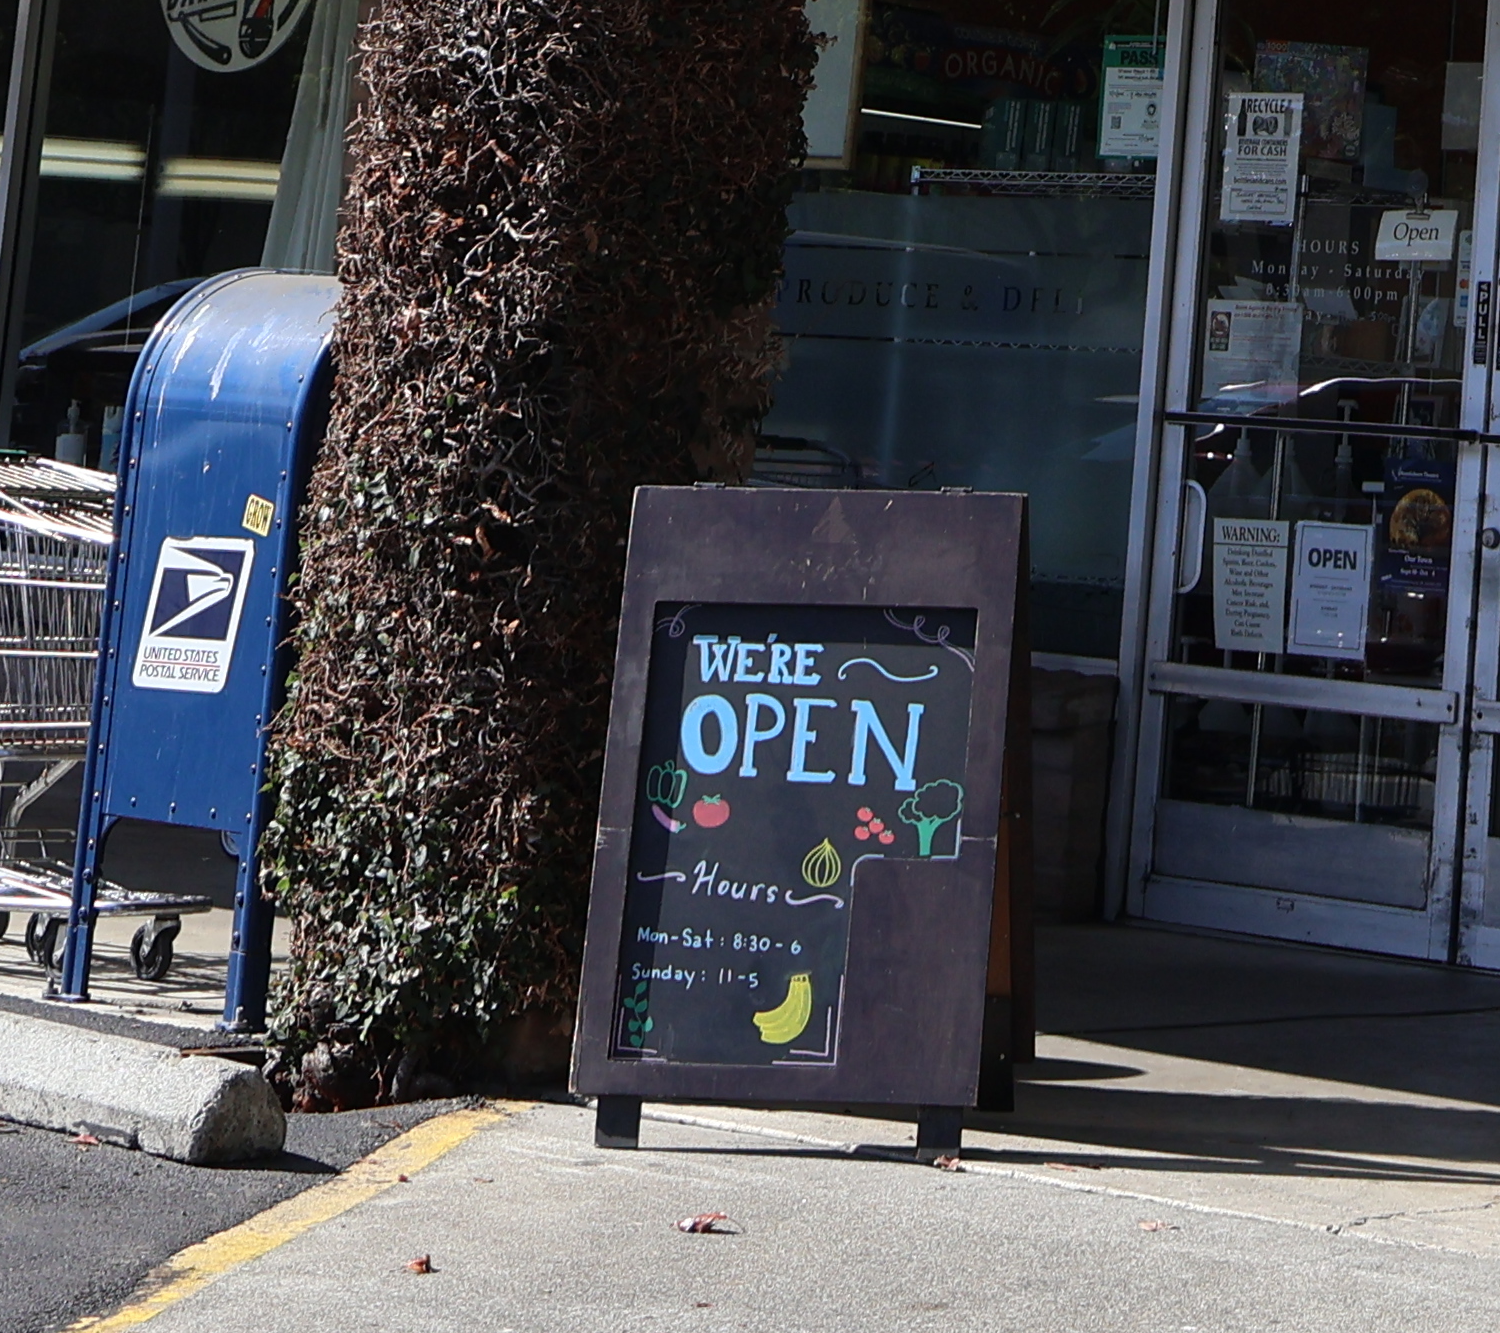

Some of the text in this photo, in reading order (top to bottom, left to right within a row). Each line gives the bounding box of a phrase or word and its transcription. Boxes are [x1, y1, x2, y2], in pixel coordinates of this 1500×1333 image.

[1119, 49, 1159, 65] PASS
[945, 49, 1063, 96] ORGANIC
[1238, 145, 1287, 157] FOR CASH
[1393, 222, 1440, 247] Open
[1299, 238, 1361, 255] HOURS
[1343, 262, 1425, 281] Saturday
[1477, 291, 1489, 340] PULL
[1221, 525, 1281, 543] WARNING:
[1307, 547, 1358, 572] OPEN
[143, 644, 219, 664] UNITED STATES
[693, 633, 824, 686] WE'RE
[139, 663, 220, 683] POSTAL SERVICE
[680, 694, 925, 792] OPEN
[691, 859, 779, 904] Hours
